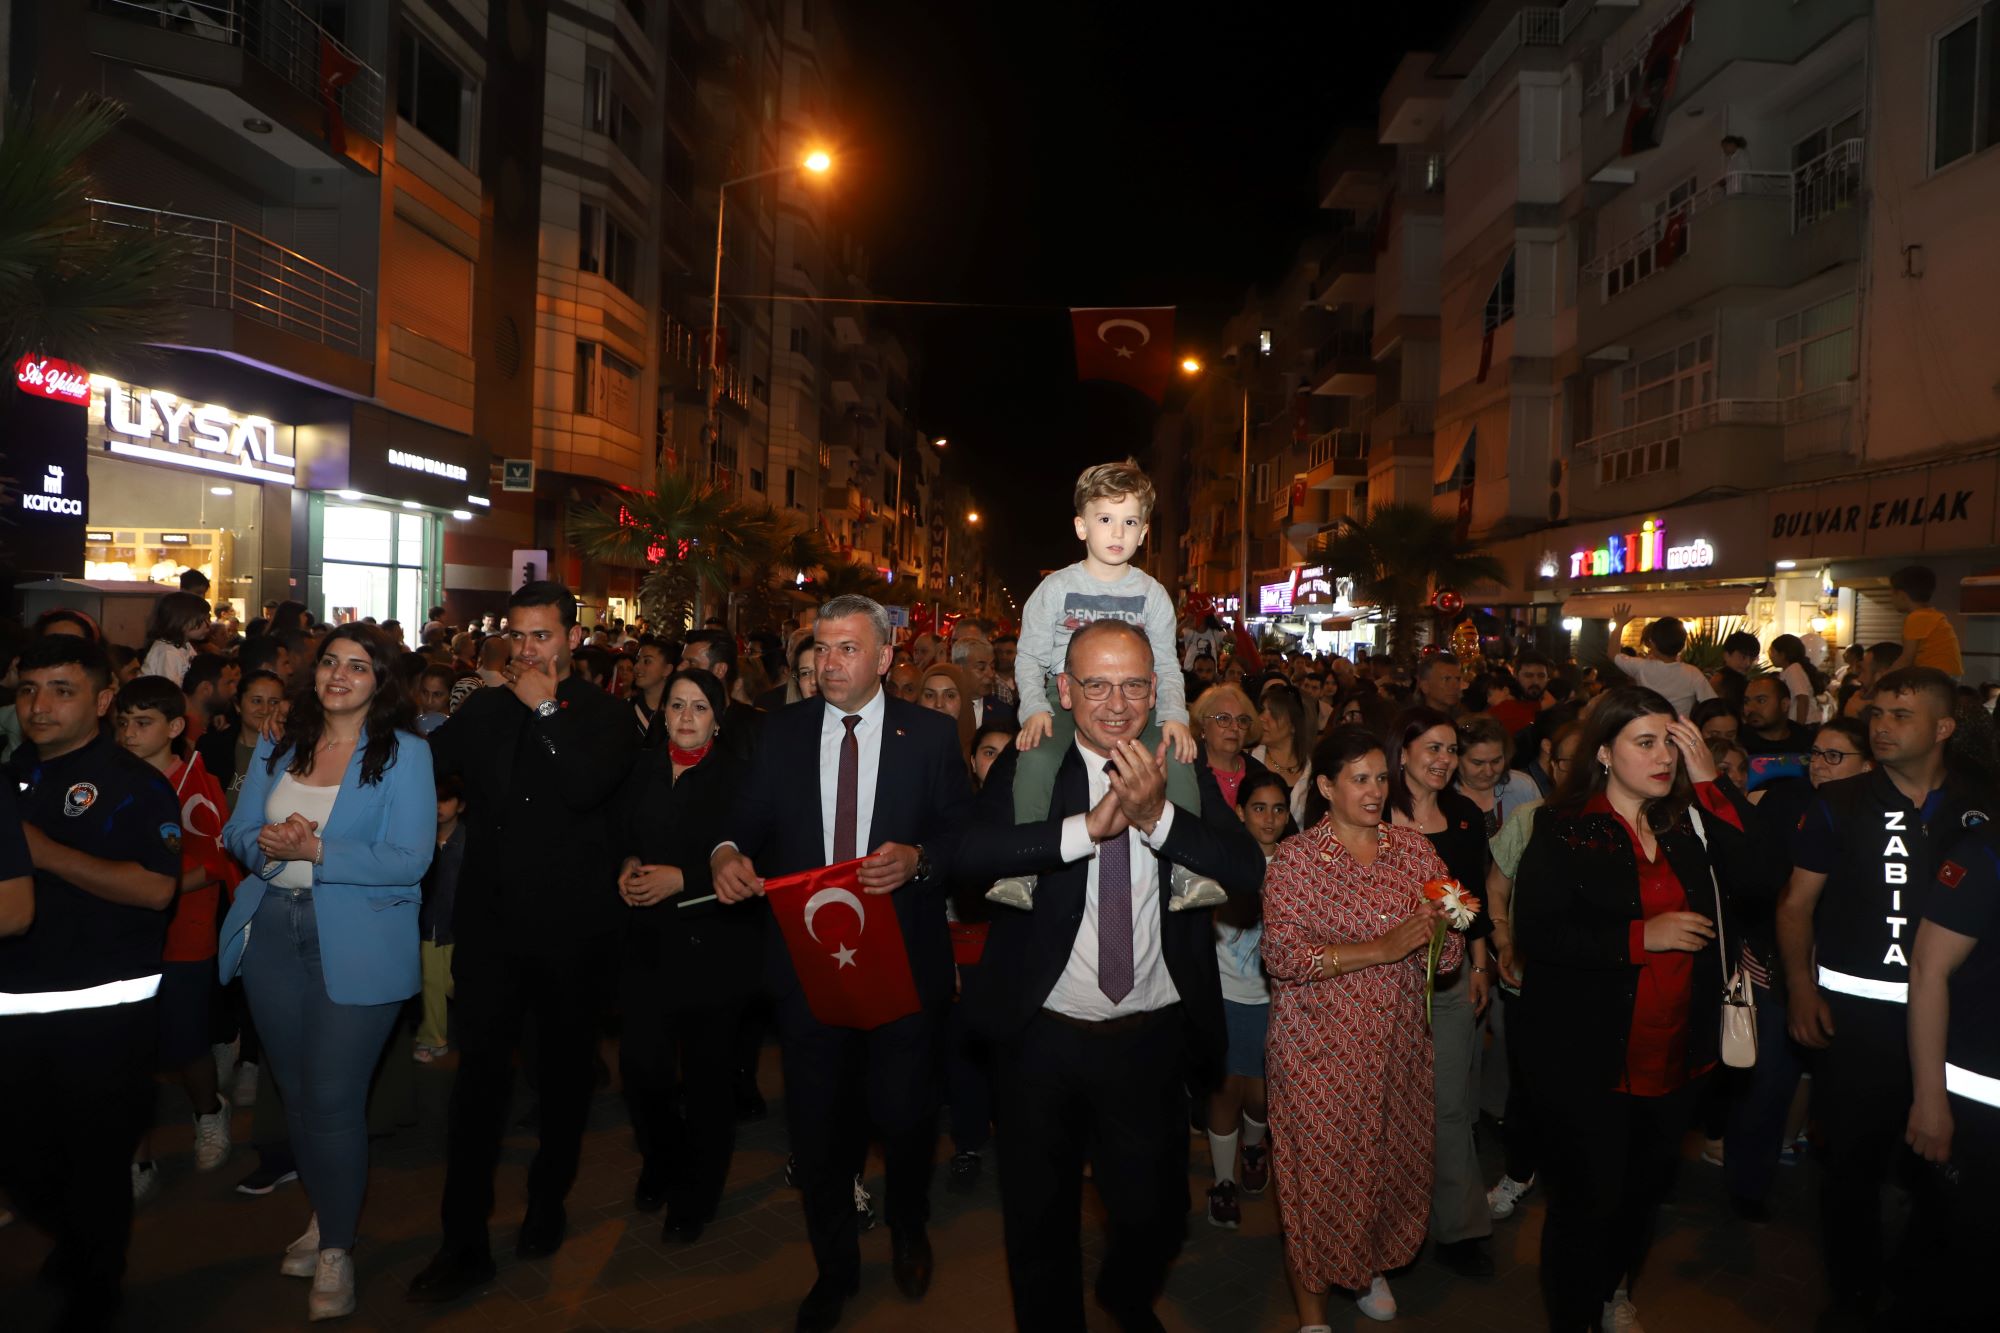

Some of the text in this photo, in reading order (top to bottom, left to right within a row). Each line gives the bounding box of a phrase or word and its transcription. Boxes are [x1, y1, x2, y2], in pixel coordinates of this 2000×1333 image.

[108, 384, 295, 468] UYSAL
[23, 494, 82, 515] karaca
[1771, 490, 1975, 538] BULVAR EMLAK
[1883, 811, 1909, 966] ZABITA
